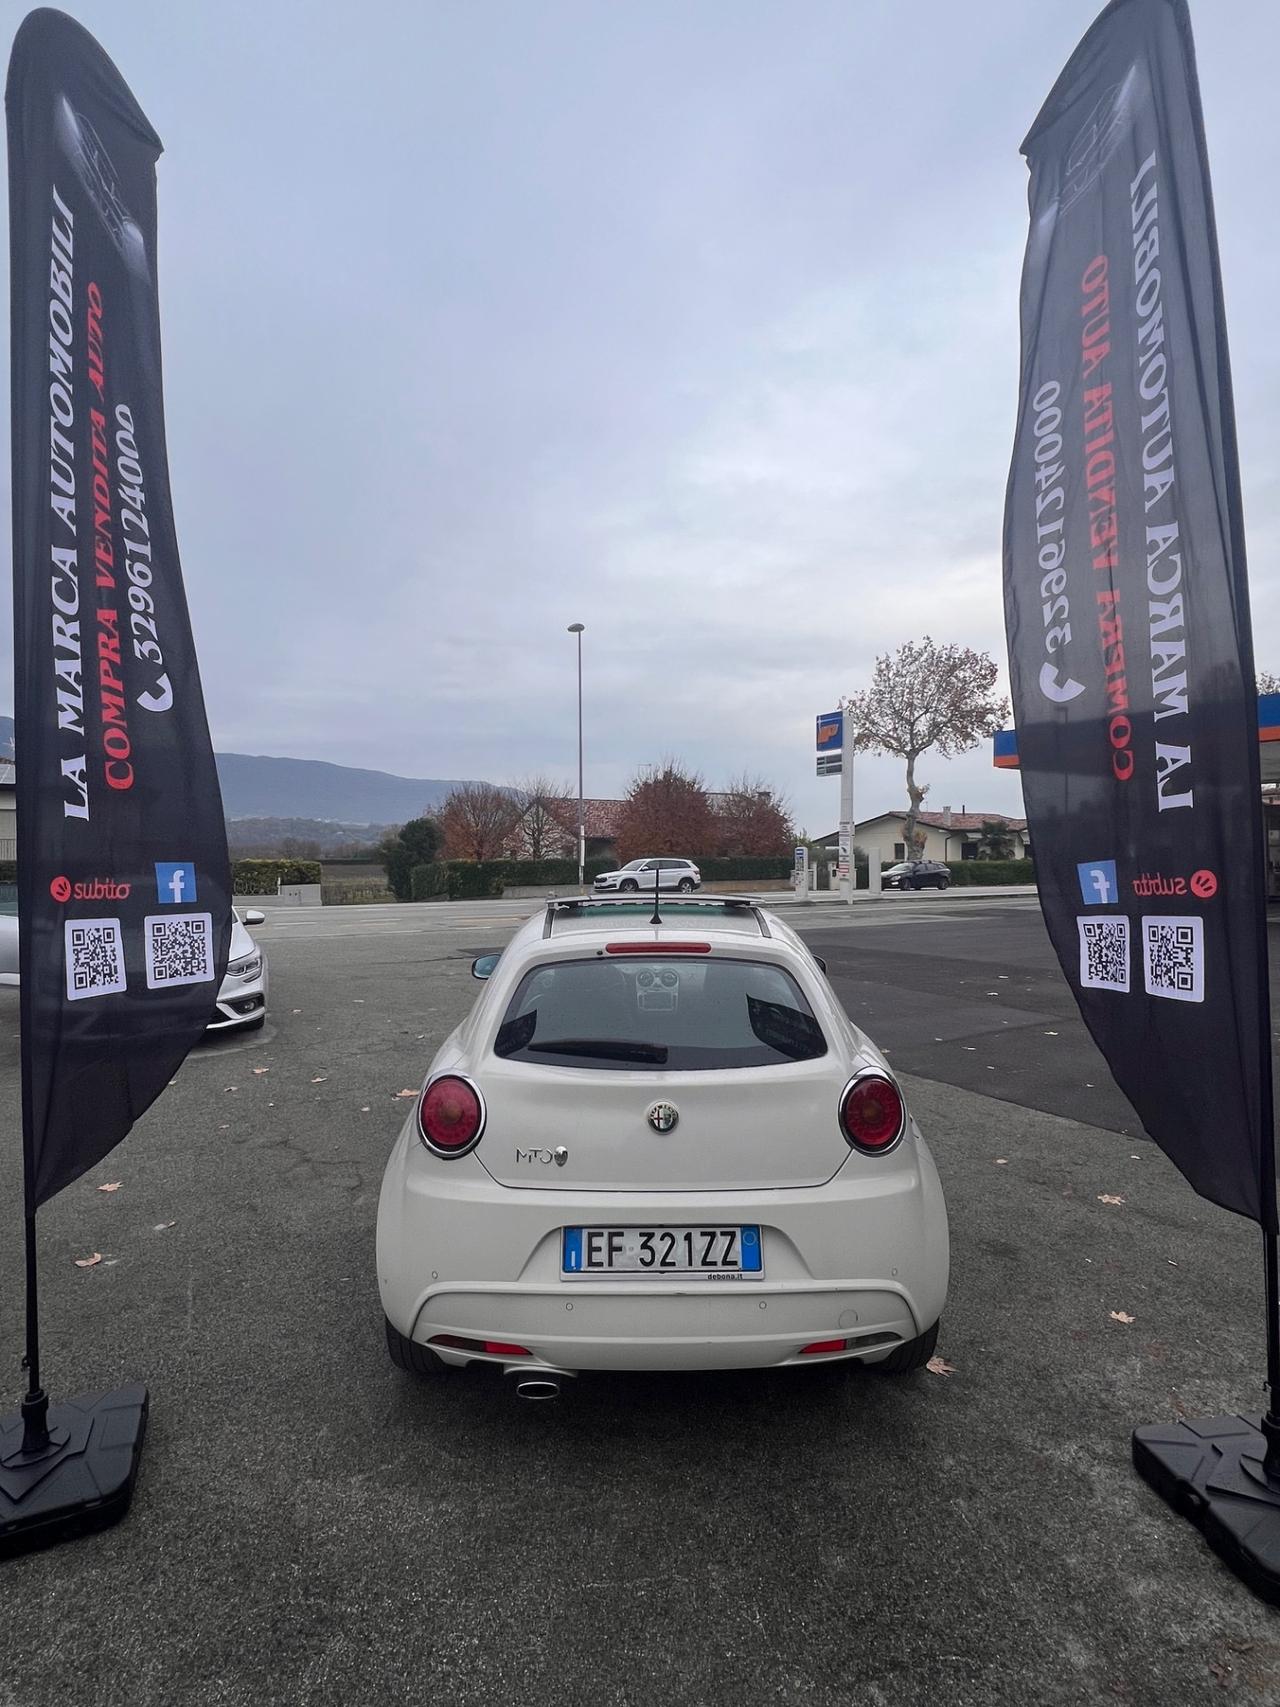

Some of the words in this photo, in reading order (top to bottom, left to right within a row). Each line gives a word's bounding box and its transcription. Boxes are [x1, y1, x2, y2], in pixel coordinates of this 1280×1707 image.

[50, 184, 77, 536] AUTOMOBILI
[87, 281, 105, 402] AUTO
[90, 408, 116, 589] VENDITA
[115, 404, 163, 665] 3296124000
[51, 544, 85, 737] MARCA
[97, 608, 135, 790] COMPRA
[61, 754, 90, 822] LA
[73, 877, 131, 900] subito
[587, 1231, 625, 1267] EF
[639, 1231, 738, 1267] 321ZZ
